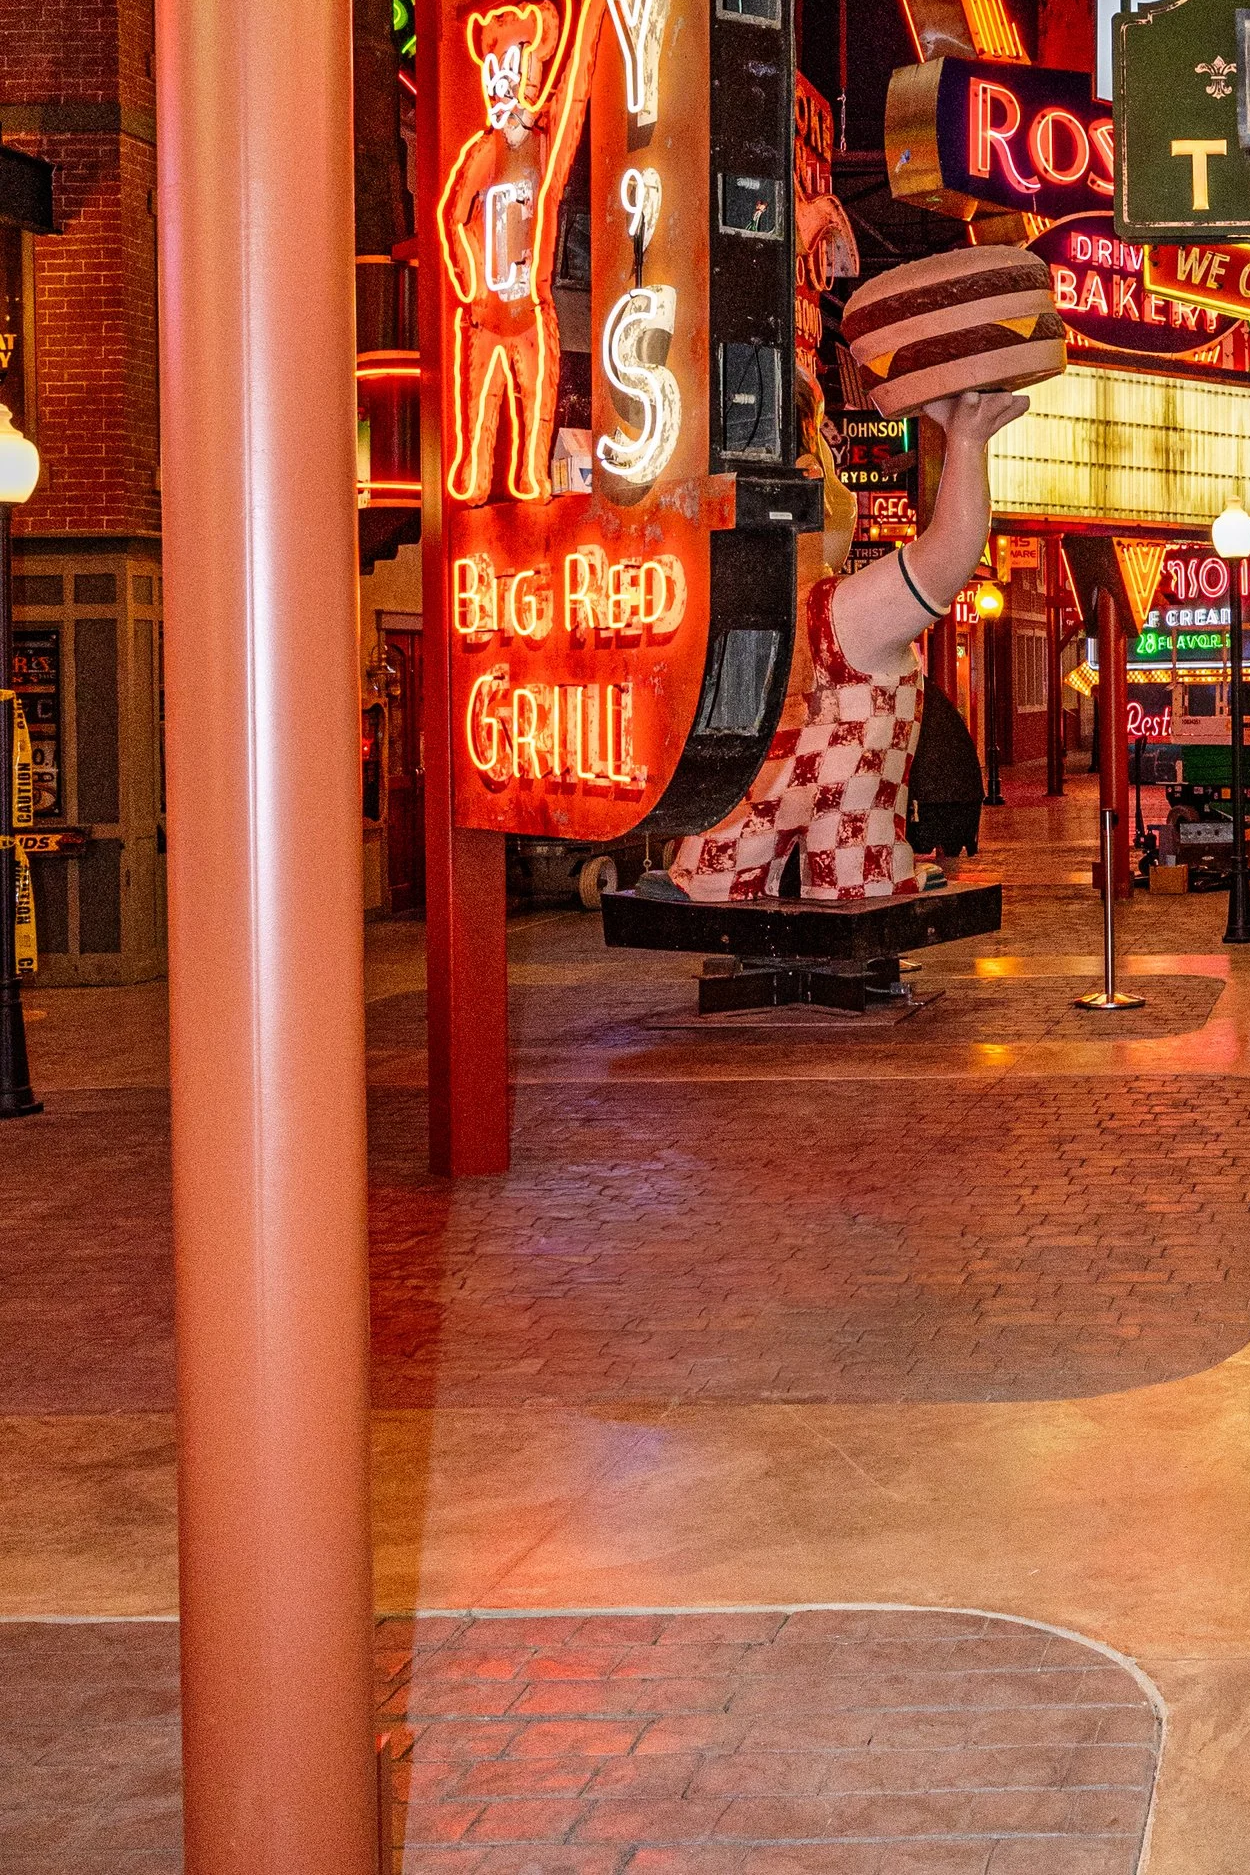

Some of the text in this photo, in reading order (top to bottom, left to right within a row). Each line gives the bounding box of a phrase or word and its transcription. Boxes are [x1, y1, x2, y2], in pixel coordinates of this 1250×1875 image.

[1176, 246, 1230, 288] WE
[454, 543, 688, 643] BIG RED
[1137, 634, 1156, 654] 28
[466, 663, 649, 790] GRILL
[1127, 702, 1172, 737] Rest
[17, 762, 32, 824] CAUTION
